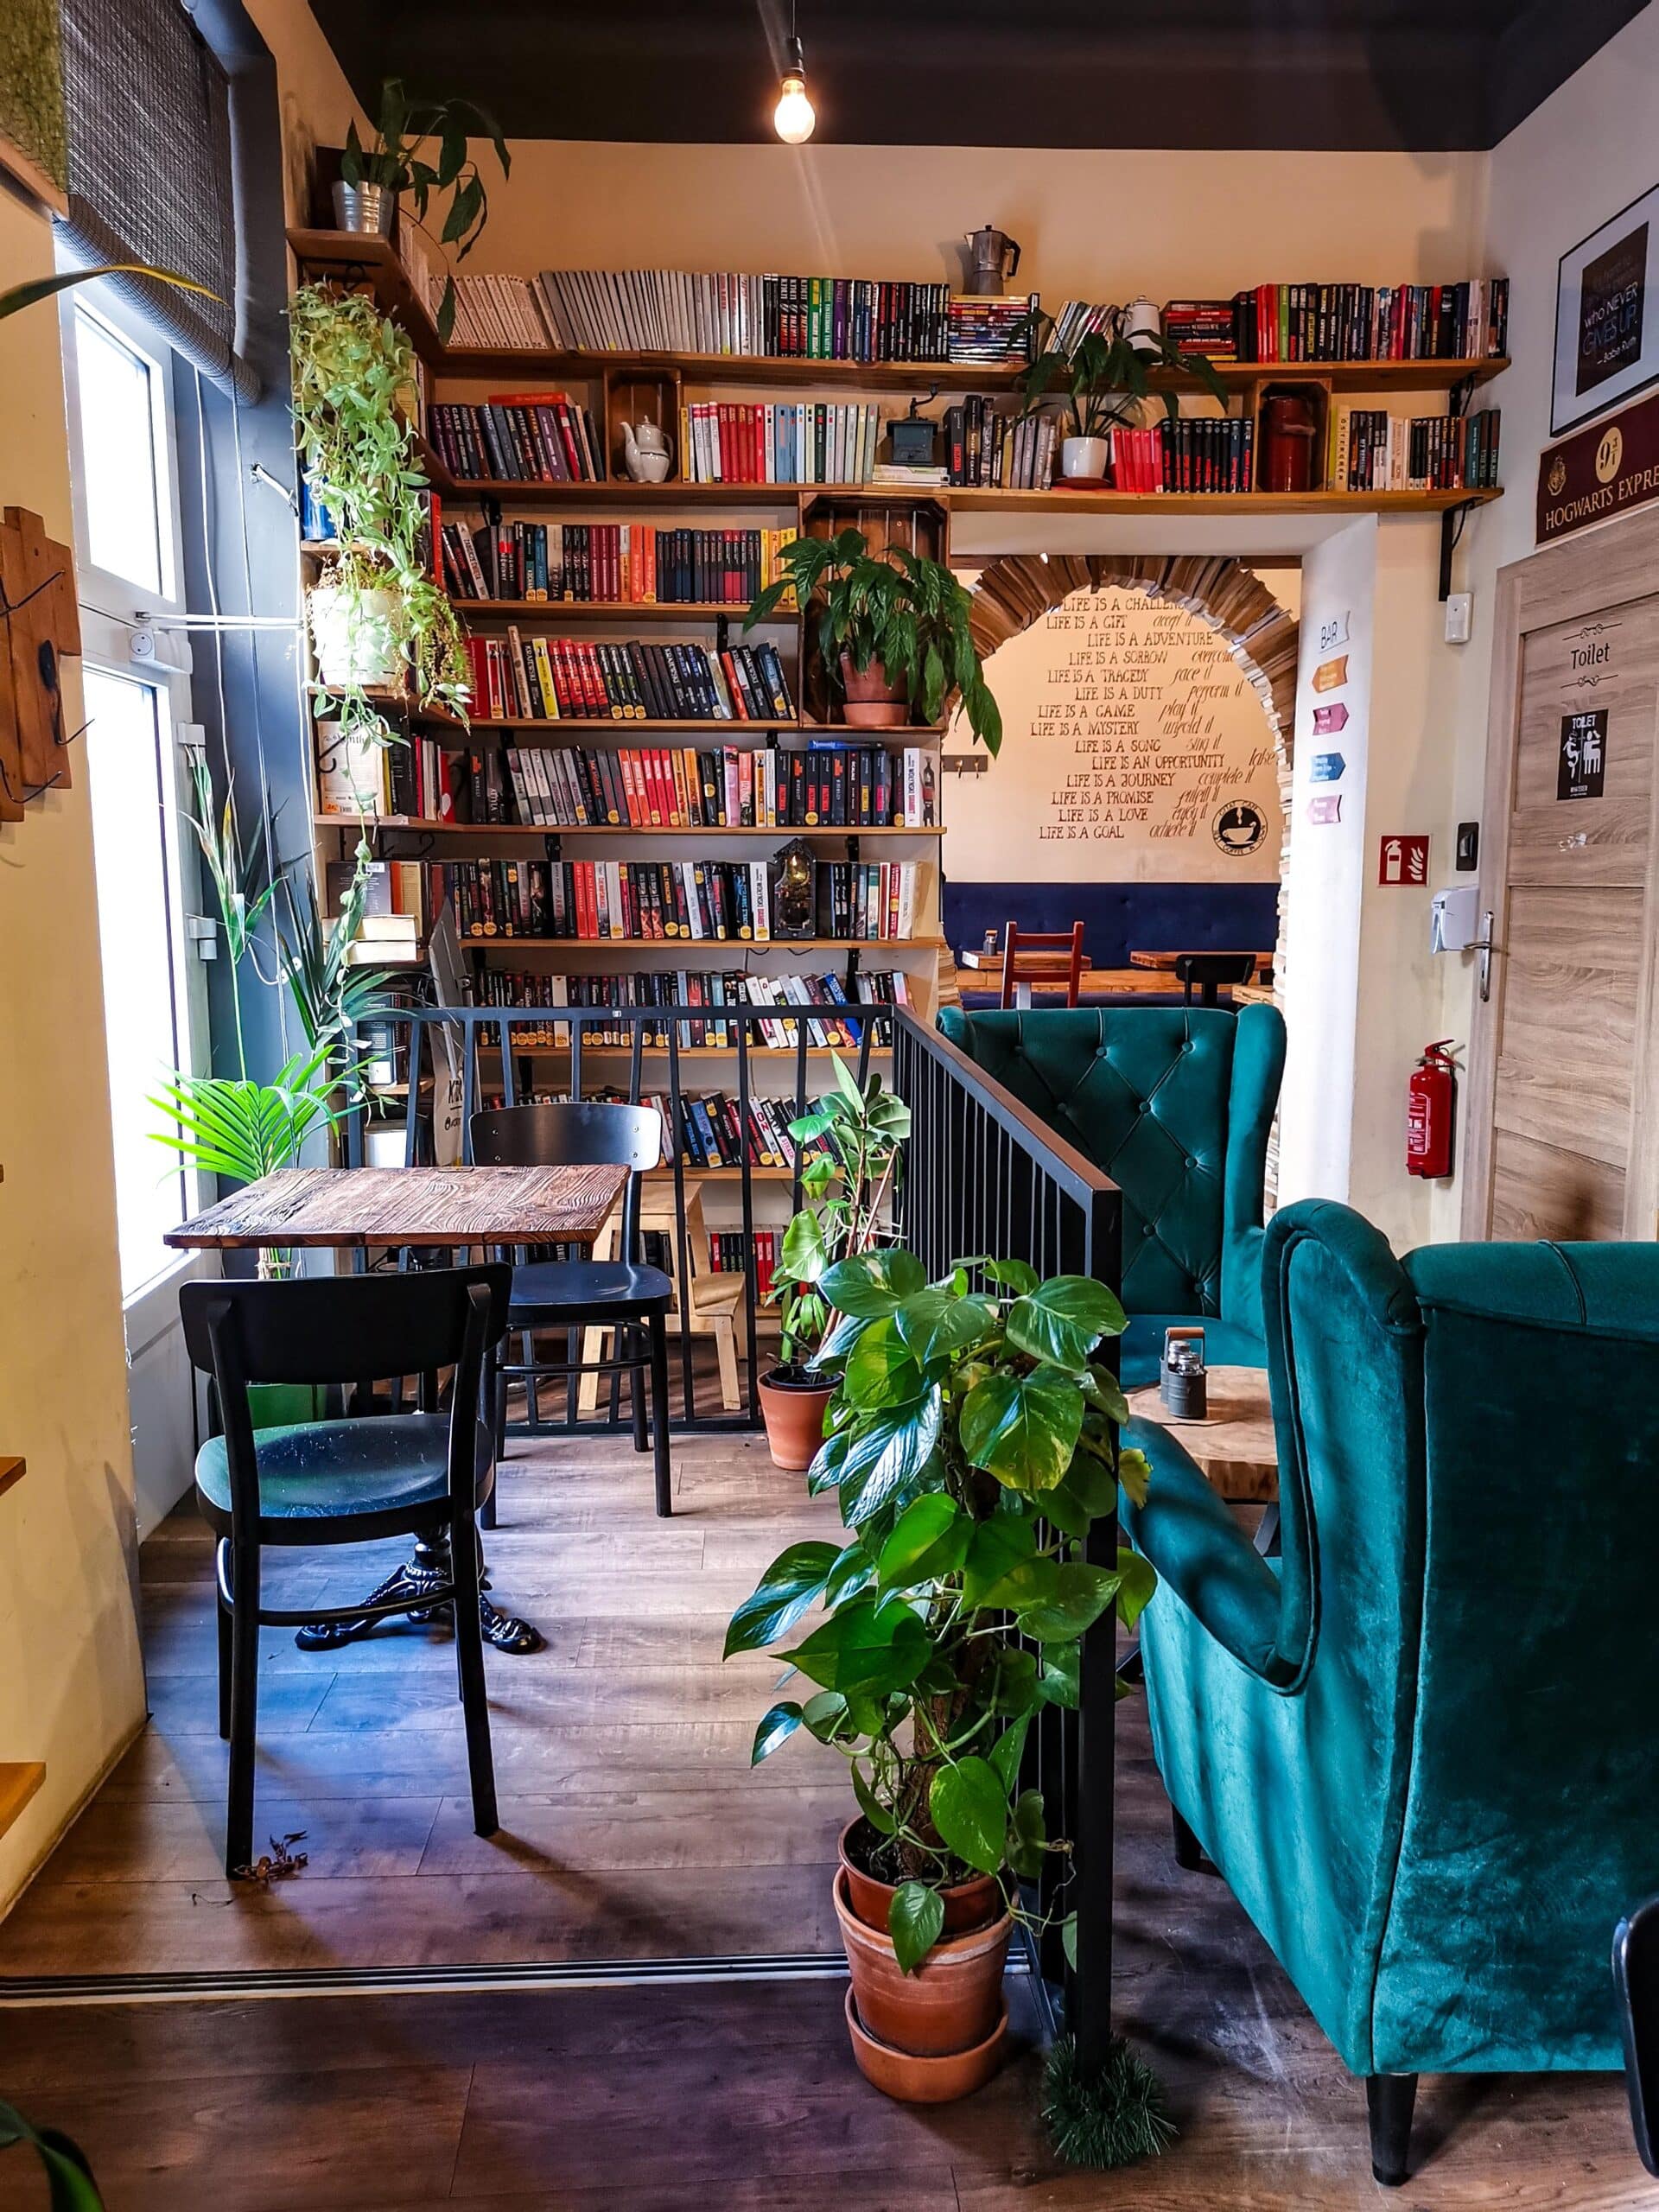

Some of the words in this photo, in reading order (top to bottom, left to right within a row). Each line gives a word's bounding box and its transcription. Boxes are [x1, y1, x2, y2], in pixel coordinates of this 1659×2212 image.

[1546, 486, 1613, 531] HOGWARTS
[1064, 598, 1090, 612] LIFE
[1095, 597, 1107, 611] IS
[1111, 598, 1121, 611] A
[1046, 616, 1071, 629] LIFE
[1075, 616, 1085, 629] IS
[1089, 616, 1098, 629] A
[1103, 615, 1127, 629] GIFT
[1087, 633, 1111, 647] LIFE
[1116, 632, 1125, 646] IS
[1128, 632, 1138, 646] A
[1143, 632, 1213, 646] ADVENTURE
[1320, 621, 1338, 649] BAR
[1069, 652, 1093, 665] LIFE
[1096, 652, 1106, 664] IS
[1109, 652, 1118, 664] A
[1123, 651, 1167, 664] SORROW
[1571, 643, 1610, 670] Toilet
[664, 648, 681, 684] KRAJEWSKI
[1048, 670, 1071, 683] LIFE
[1072, 669, 1083, 683] IS
[1085, 669, 1095, 683] A
[1101, 669, 1149, 683] TRAGEDY
[1170, 668, 1201, 686] face
[1075, 687, 1098, 700] LIFE
[1103, 686, 1115, 700] IS
[1118, 686, 1128, 700] A
[1134, 686, 1164, 700] DUTY
[1186, 684, 1230, 703] perform
[1038, 705, 1062, 718] LIFE
[1065, 704, 1076, 718] IS
[1079, 704, 1088, 718] A
[1096, 704, 1135, 717] GAME
[1158, 699, 1186, 722] play
[1030, 722, 1055, 736] LIFE
[1059, 722, 1070, 735] IS
[1072, 722, 1082, 735] A
[1088, 721, 1140, 735] MYSTERY
[1163, 715, 1203, 738] unfold
[1572, 715, 1597, 729] TOILET
[1075, 741, 1098, 753] LIFE
[1103, 740, 1112, 753] IS
[1116, 740, 1124, 753] A
[1130, 740, 1161, 752] SONG
[1186, 738, 1210, 754] sing
[1092, 756, 1116, 770] LIFE
[1121, 756, 1129, 770] IS
[1133, 755, 1150, 769] AN
[1155, 753, 1225, 769] OPPORTUNITY
[1249, 747, 1275, 766] take
[1066, 774, 1090, 787] LIFE
[1094, 774, 1103, 787] IS
[1105, 774, 1116, 787] A
[1121, 773, 1176, 787] JOURNEY
[1198, 766, 1243, 785] complete
[1051, 791, 1077, 805] LIFE
[1081, 791, 1090, 804] IS
[1092, 791, 1103, 804] A
[1106, 791, 1154, 804] PROMISE
[1058, 809, 1084, 822] LIFE
[1089, 809, 1099, 822] IS
[1104, 809, 1114, 822] A
[1119, 808, 1148, 821] LOVE
[1172, 807, 1198, 825] enjoy
[1039, 826, 1064, 839] LIFE
[1066, 826, 1077, 839] IS
[1078, 826, 1089, 839] A
[1094, 825, 1124, 839] GOAL
